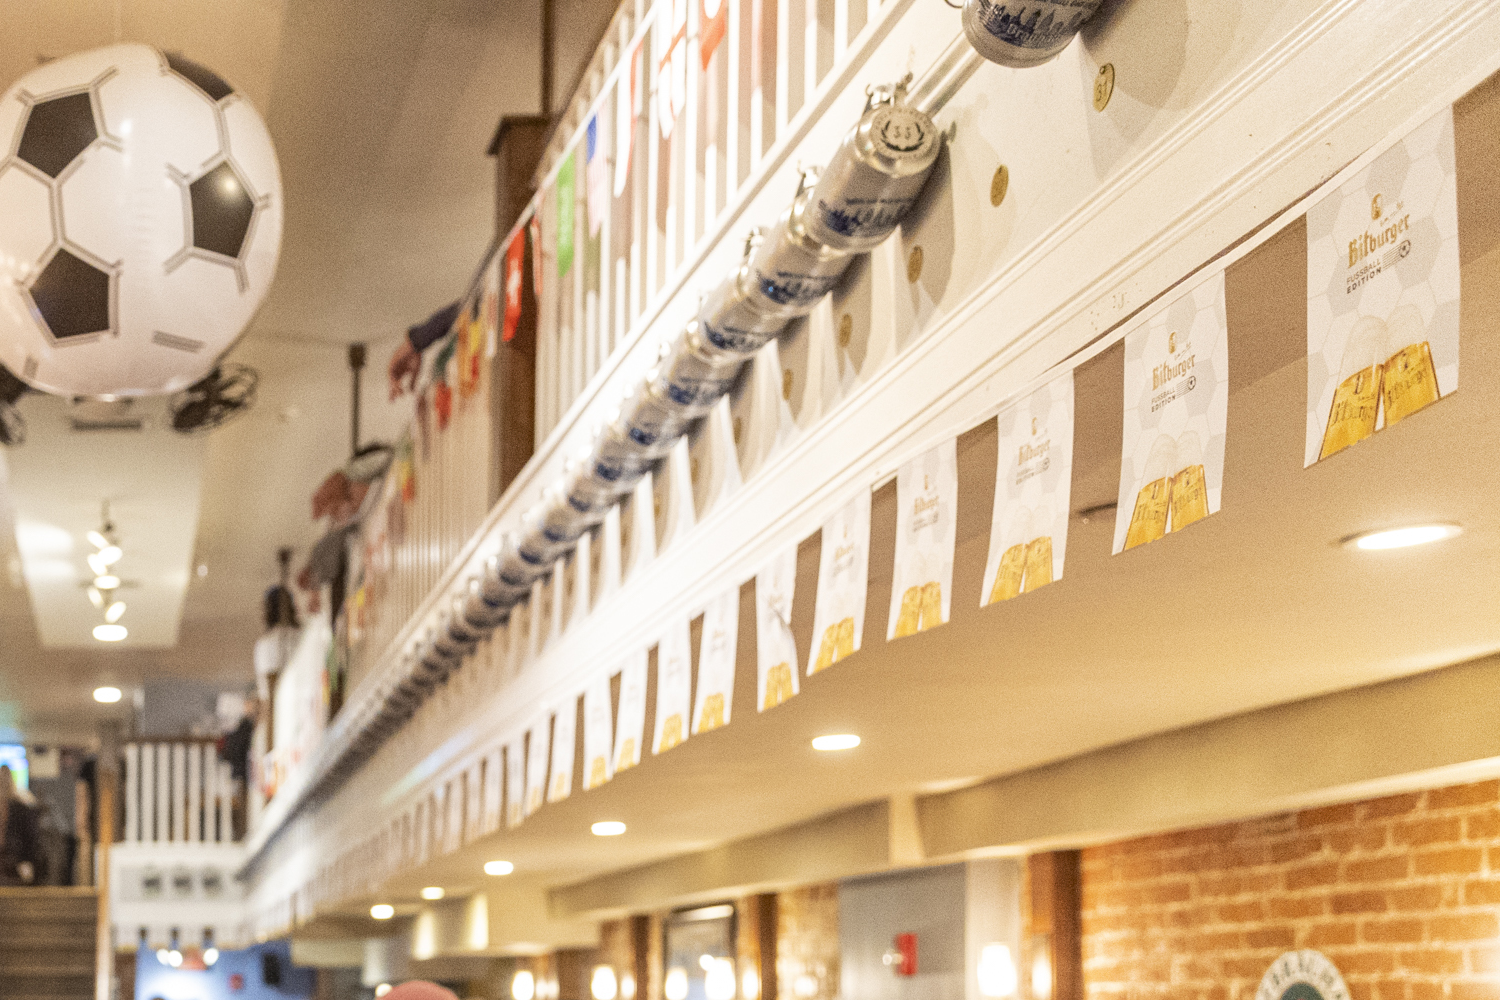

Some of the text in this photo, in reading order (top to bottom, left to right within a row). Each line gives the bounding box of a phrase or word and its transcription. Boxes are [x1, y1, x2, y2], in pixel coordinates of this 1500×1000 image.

[1348, 213, 1410, 269] Bitburger
[1346, 258, 1381, 285] FUSSBALL
[1346, 267, 1382, 294] EDITION
[1152, 354, 1196, 391] Bitburger
[1151, 387, 1176, 404] FUSSBALL
[1151, 394, 1176, 413] EDITION
